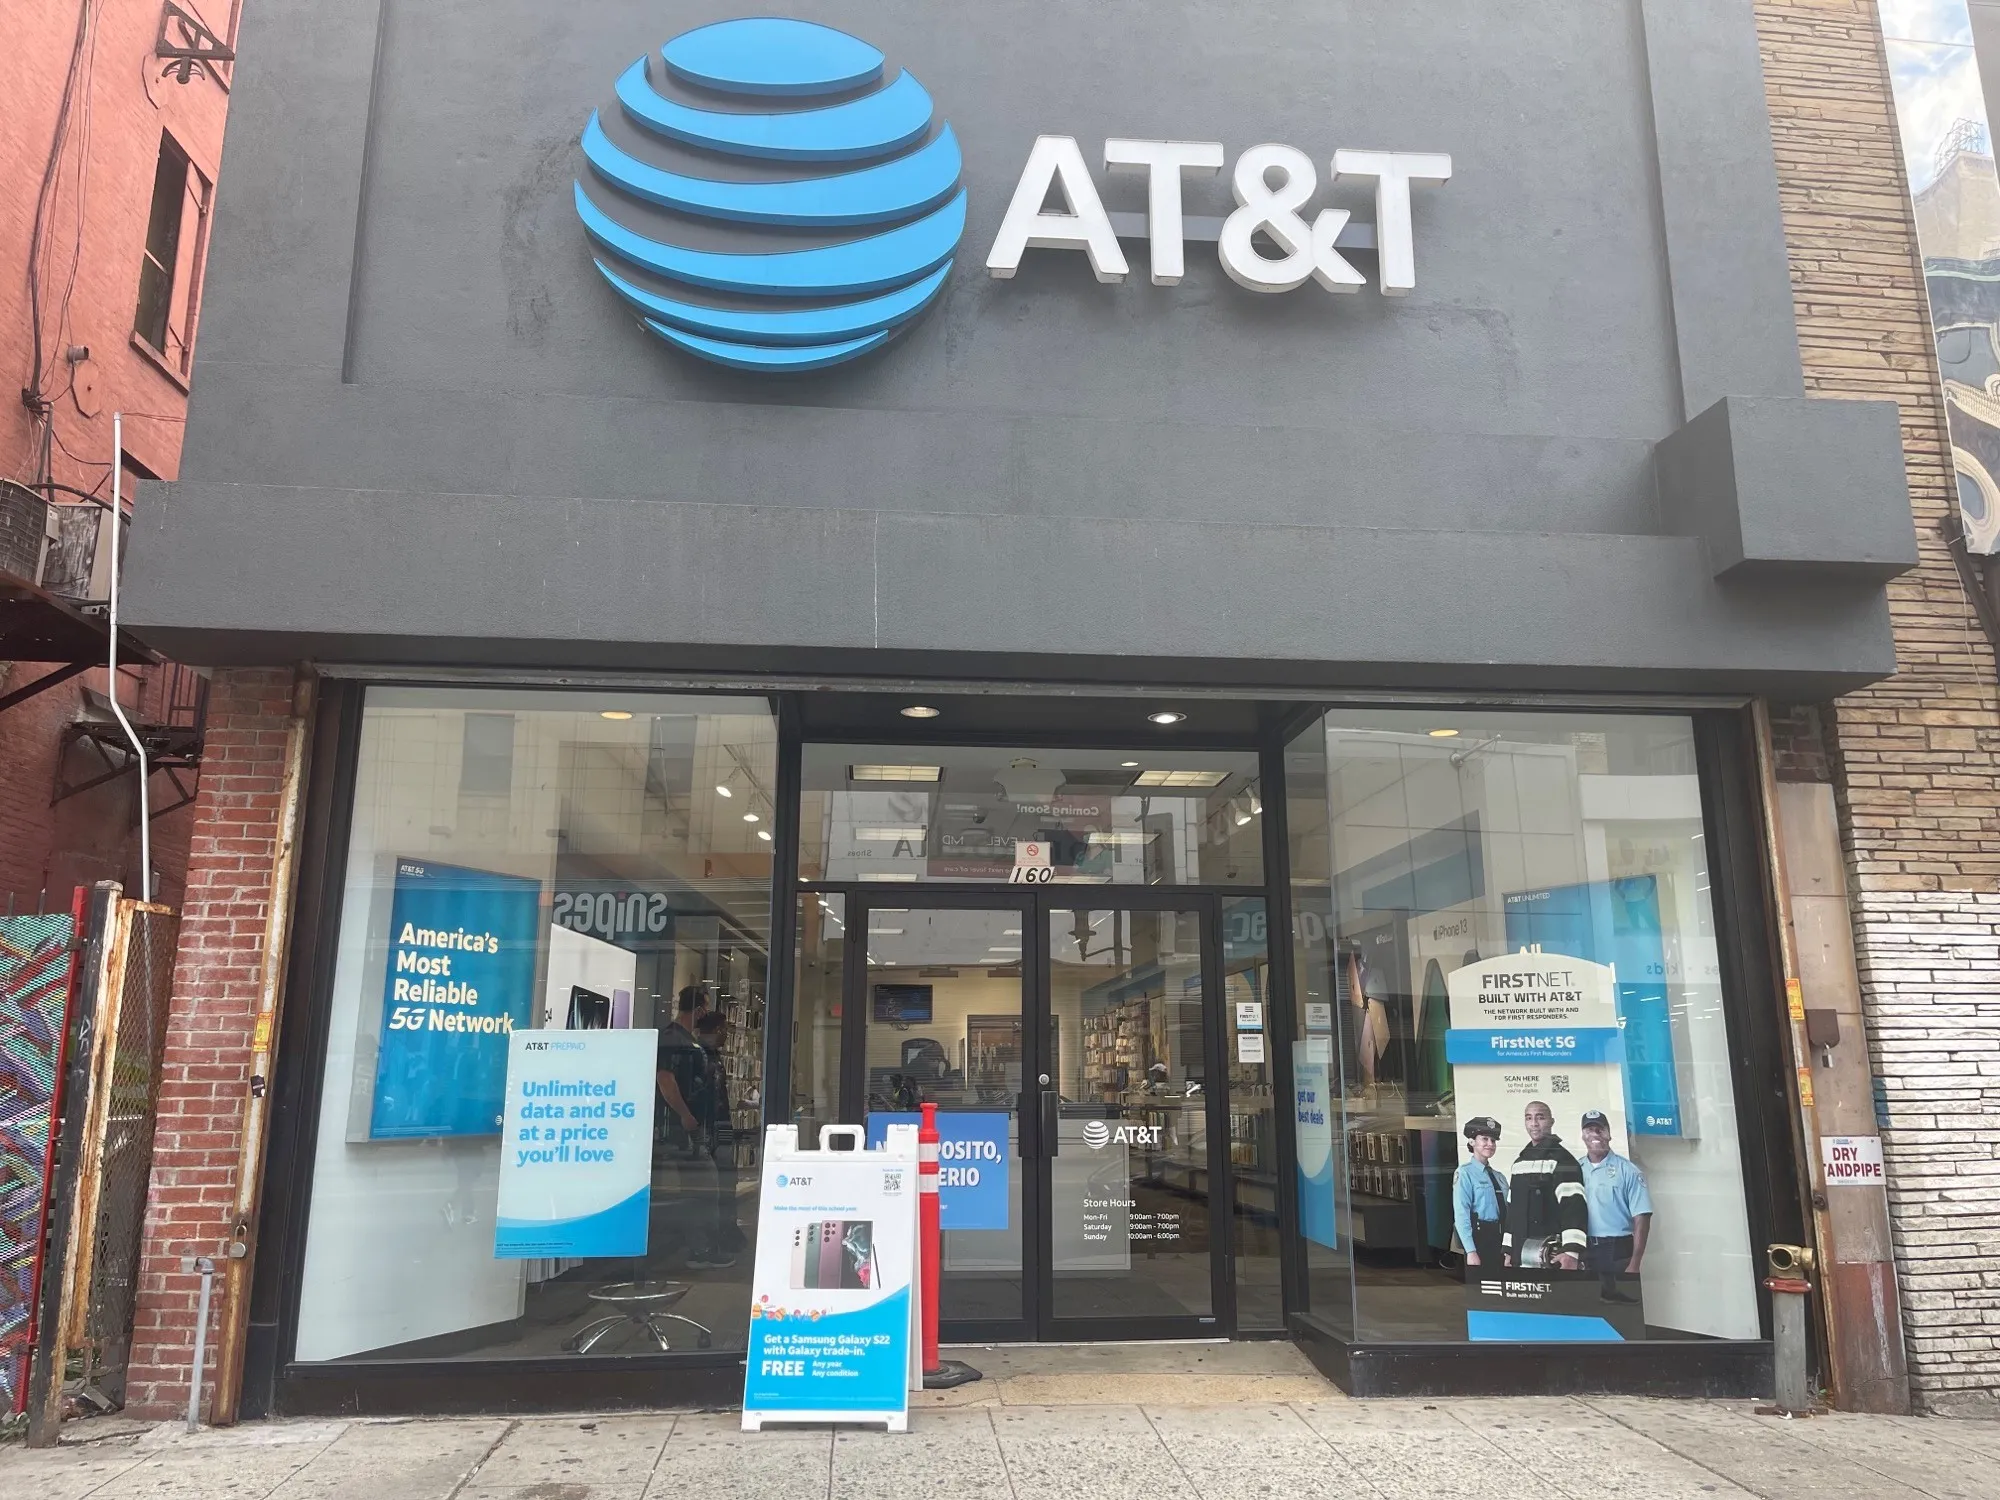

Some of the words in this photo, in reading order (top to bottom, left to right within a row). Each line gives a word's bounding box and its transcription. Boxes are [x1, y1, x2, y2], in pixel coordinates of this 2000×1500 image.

[986, 135, 1452, 297] AT&T
[1014, 867, 1051, 883] 160
[1507, 895, 1521, 903] AT&T
[1522, 892, 1551, 902] UNLIMITED
[399, 922, 498, 954] America's
[1437, 924, 1460, 939] iPhone
[396, 950, 451, 976] Most
[394, 978, 478, 1005] Reliable
[1478, 993, 1510, 1004] BUILT
[1514, 992, 1546, 1003] WITH
[1550, 991, 1582, 1002] AT&T
[389, 1007, 426, 1031] 5G
[428, 1009, 514, 1034] Network
[525, 1042, 549, 1051] AT&T
[550, 1042, 586, 1051] PREPAID
[1555, 1036, 1576, 1048] 5G
[522, 1080, 616, 1097] Unlimited
[520, 1102, 564, 1119] data
[570, 1101, 605, 1118] and
[610, 1102, 636, 1118] 5G
[1656, 1117, 1673, 1126] AT&T
[519, 1126, 540, 1141] at
[544, 1128, 556, 1140] a
[561, 1123, 608, 1144] price
[1113, 1126, 1162, 1144] AT&T
[516, 1145, 569, 1168] you'll
[575, 1146, 614, 1162] love
[938, 1141, 1001, 1164] OSITO,
[1832, 1147, 1858, 1161] DRY
[789, 1177, 813, 1187] AT&T
[1083, 1199, 1108, 1207] Store
[1109, 1199, 1136, 1207] Hours
[1157, 1213, 1180, 1221] 7:00pm
[1083, 1223, 1112, 1231] Saturday
[1083, 1233, 1107, 1241] Sunday
[764, 1334, 780, 1344] Get
[791, 1335, 836, 1346] Samsung
[838, 1335, 872, 1347] Galaxy
[873, 1335, 890, 1344] S22
[763, 1345, 786, 1355] with
[788, 1345, 821, 1357] Galaxy
[823, 1346, 865, 1356] trade-in.
[761, 1360, 805, 1376] FREE
[812, 1370, 825, 1378] Any
